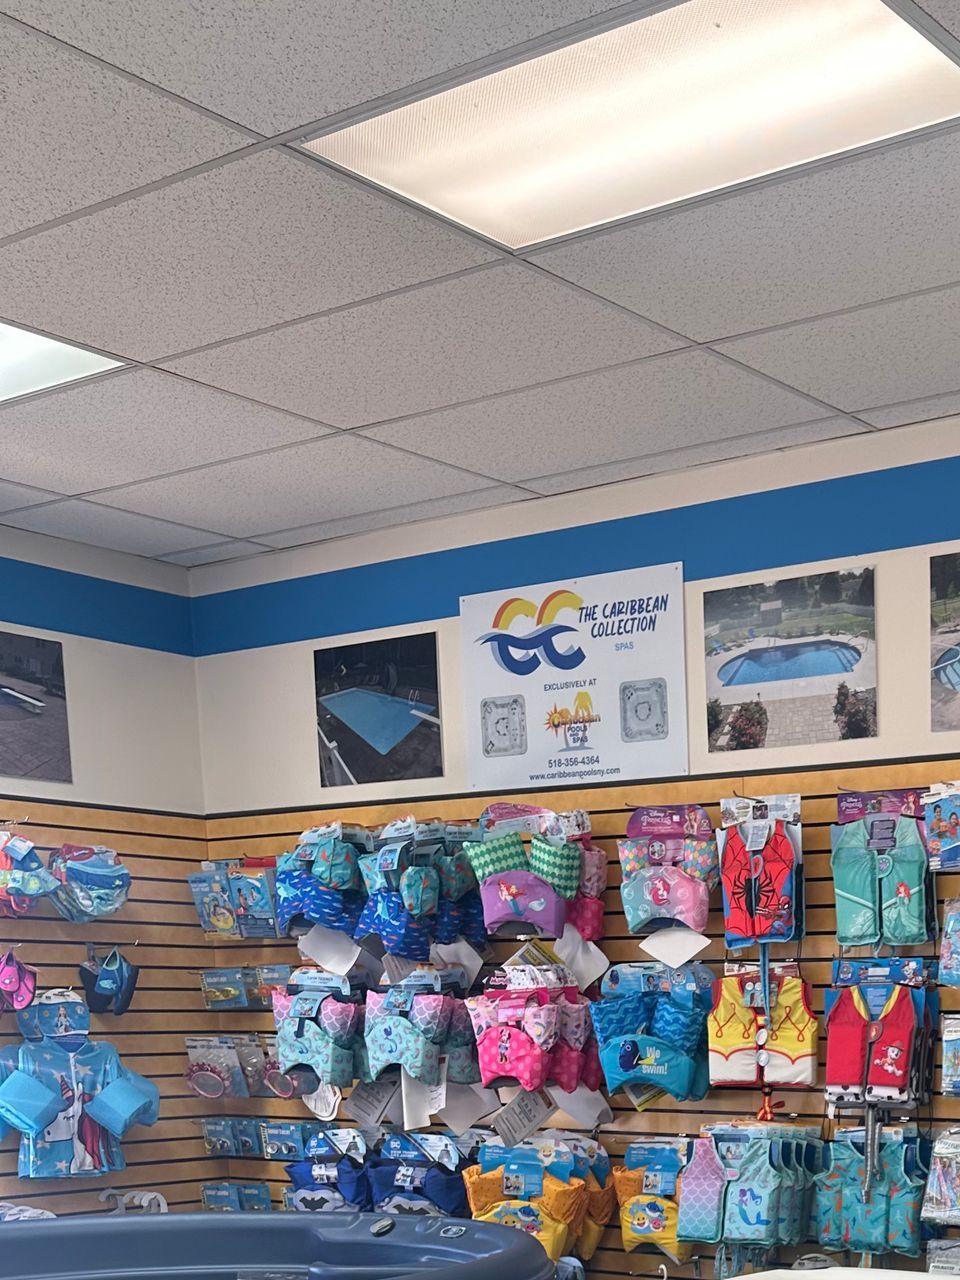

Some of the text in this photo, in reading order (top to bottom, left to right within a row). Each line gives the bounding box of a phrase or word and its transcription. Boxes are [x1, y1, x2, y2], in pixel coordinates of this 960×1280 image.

[578, 594, 669, 624] THE CARIBBEAN
[591, 614, 657, 638] COLLECTION
[614, 642, 634, 651] SPAS
[543, 678, 597, 692] EXCLUSIVELY AT
[548, 755, 600, 768] 518-356-4364
[529, 766, 621, 781] www.caribbeanpoolsny.com
[646, 1046, 661, 1058] We
[642, 1063, 668, 1075] swim!
